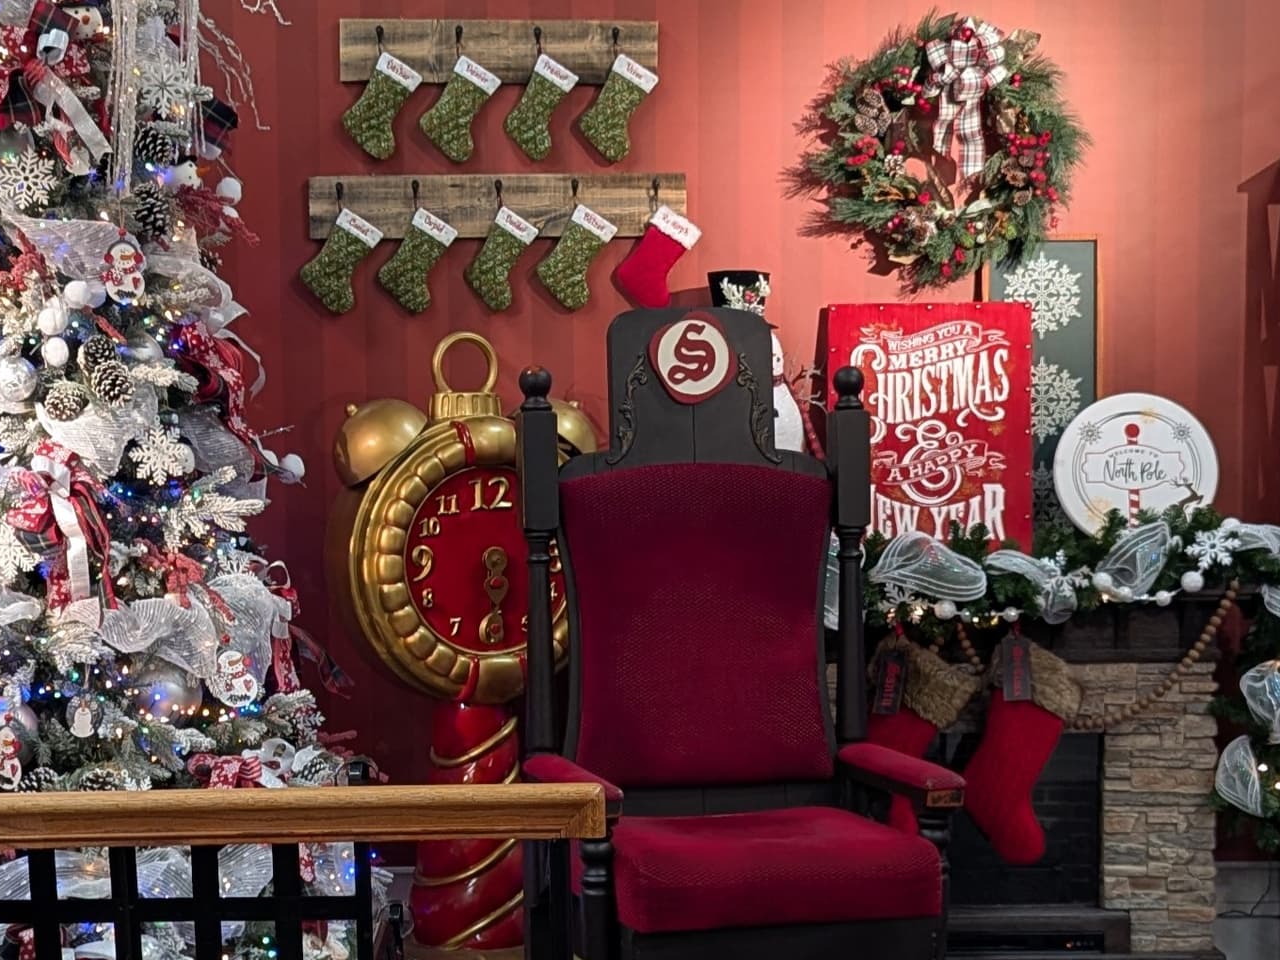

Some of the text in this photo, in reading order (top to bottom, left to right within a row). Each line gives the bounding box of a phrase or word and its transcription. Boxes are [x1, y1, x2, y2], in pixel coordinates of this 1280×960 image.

[888, 324, 973, 350] WISHING YOU A
[888, 339, 969, 370] MERRY
[850, 344, 1010, 432] CHRISTMAS
[887, 444, 978, 481] A HAPPY
[1104, 456, 1167, 484] North Pole
[435, 494, 460, 516] 11
[469, 476, 513, 511] 12
[418, 517, 441, 537] 10
[930, 483, 1006, 541] YEAR
[411, 545, 434, 582] 9
[449, 617, 462, 637] 7
